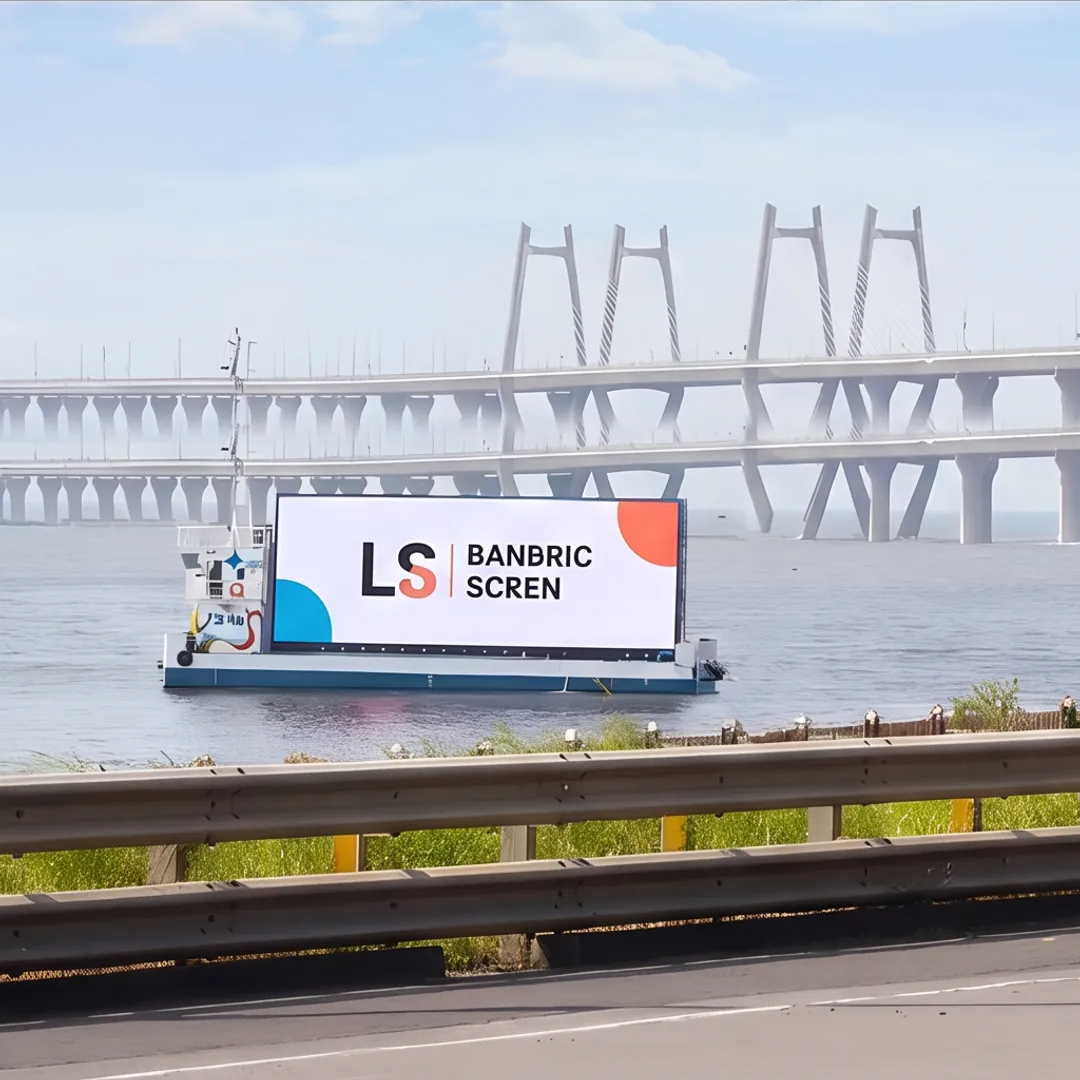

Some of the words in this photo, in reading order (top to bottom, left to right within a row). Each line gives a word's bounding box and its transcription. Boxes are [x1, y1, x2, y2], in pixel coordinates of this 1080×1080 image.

[468, 544, 592, 568] BANBRIC
[361, 542, 437, 599] LS
[466, 576, 561, 600] SCREN
